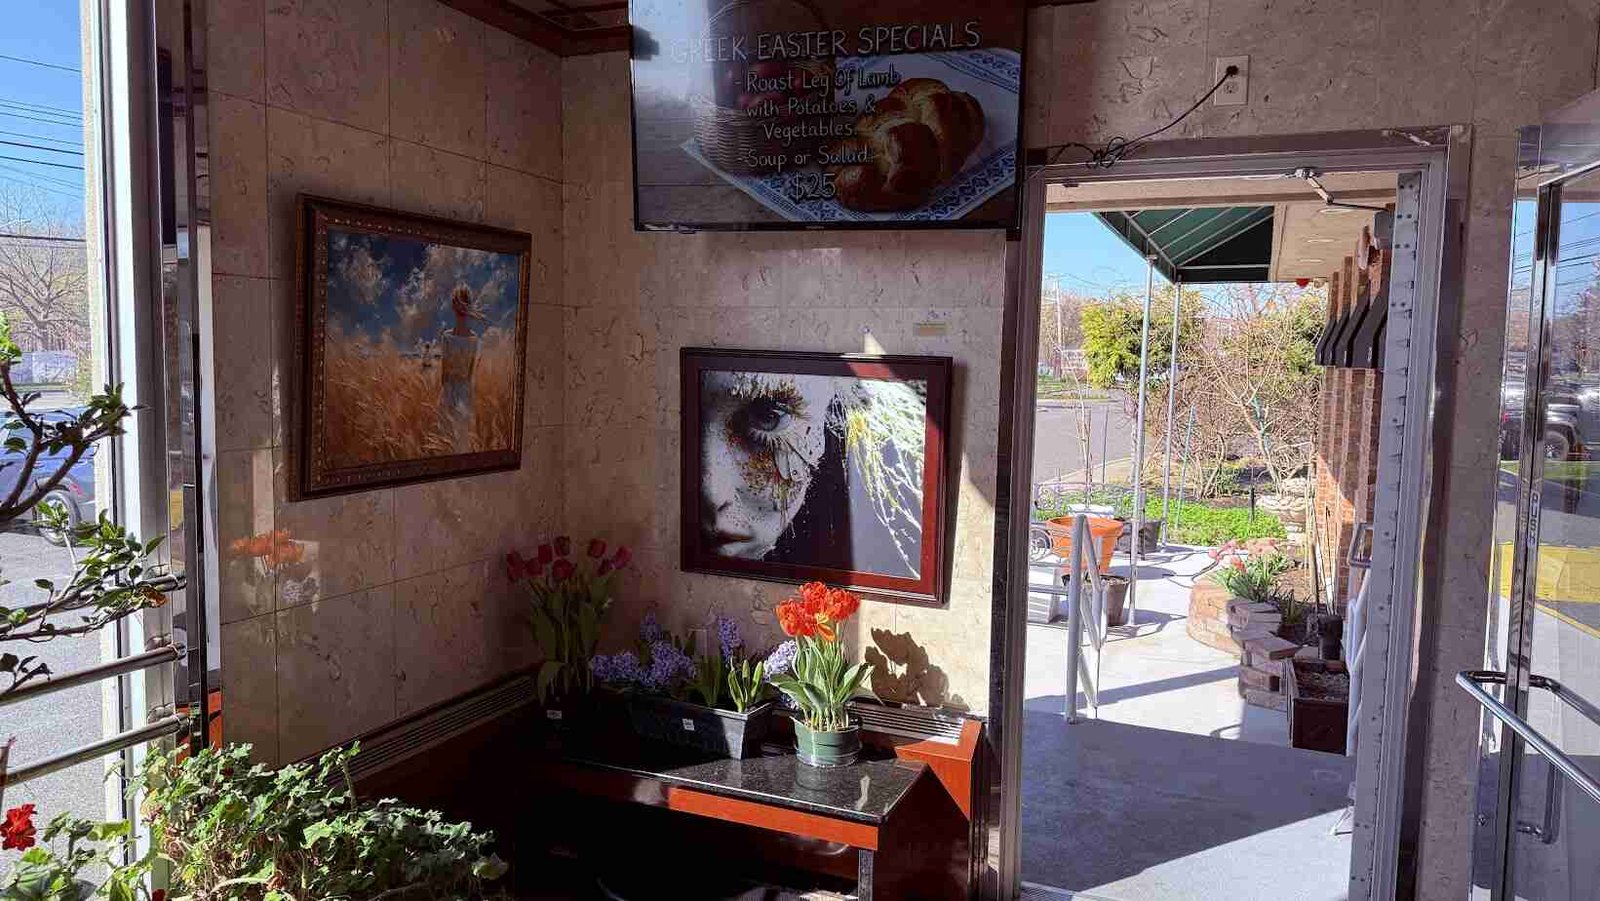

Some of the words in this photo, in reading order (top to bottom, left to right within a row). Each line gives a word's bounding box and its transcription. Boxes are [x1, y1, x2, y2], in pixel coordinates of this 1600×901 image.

[757, 30, 849, 60] EASTER
[857, 21, 983, 54] SPECIALS
[747, 70, 794, 92] Roast
[802, 71, 829, 96] Leg
[858, 62, 900, 89] Lamb
[746, 99, 779, 118] with
[788, 97, 857, 116] Potatoes
[794, 152, 812, 165] or
[791, 172, 836, 201] $25
[1529, 493, 1539, 545] PUSH
